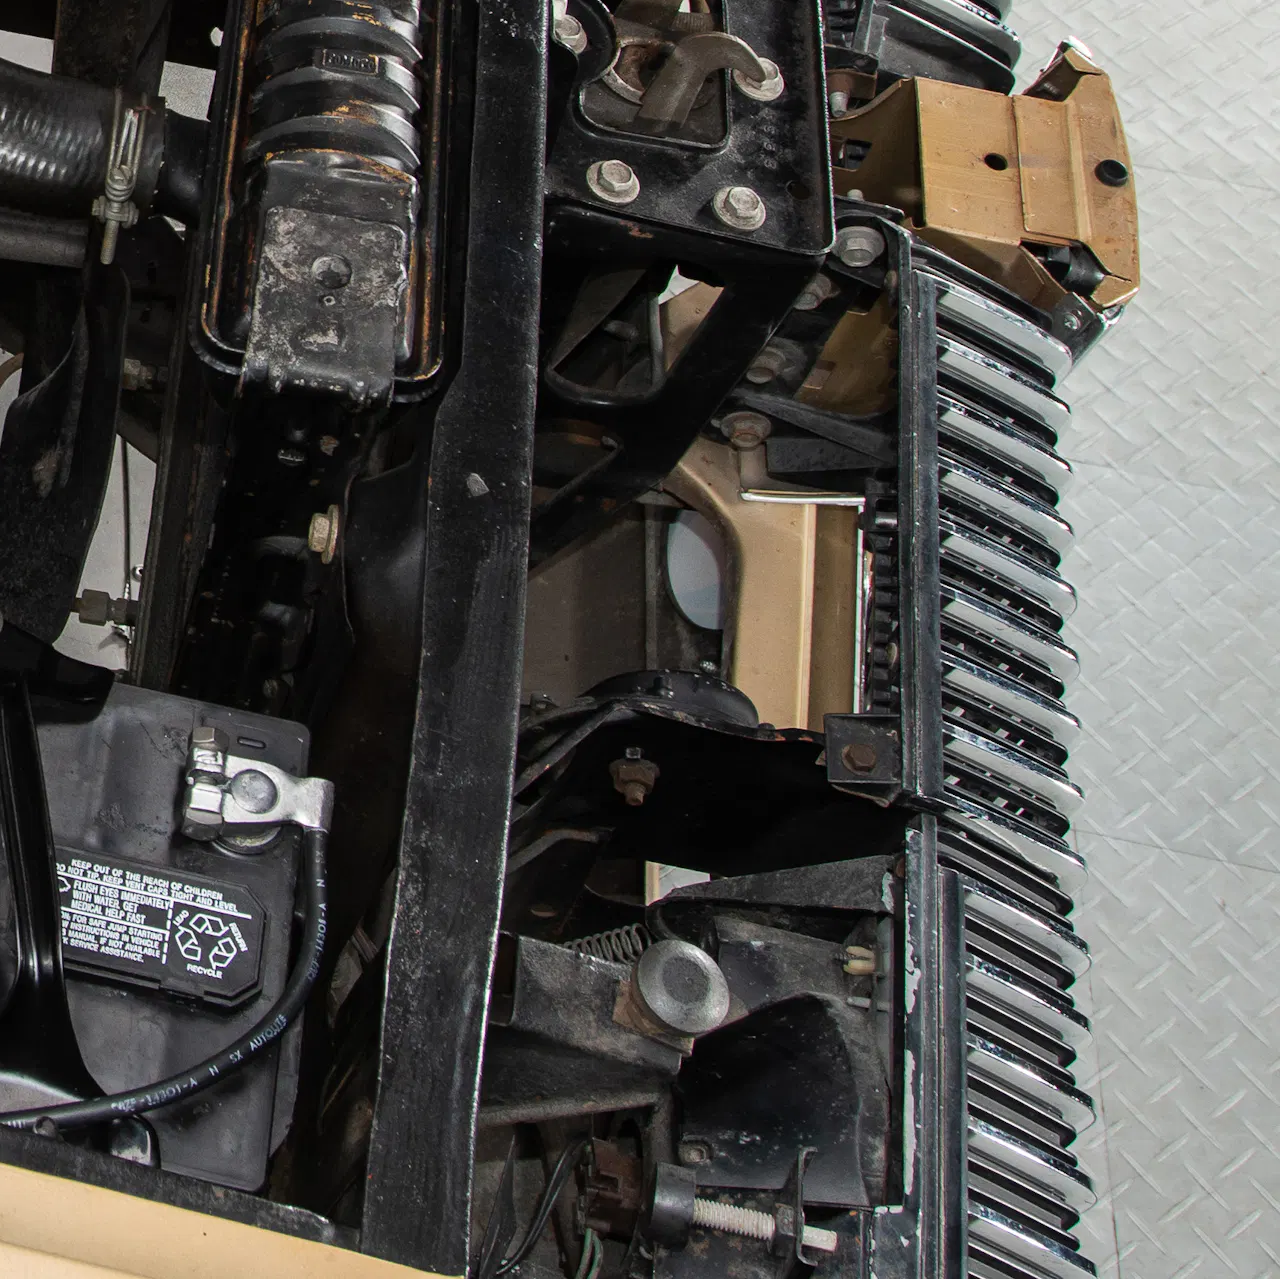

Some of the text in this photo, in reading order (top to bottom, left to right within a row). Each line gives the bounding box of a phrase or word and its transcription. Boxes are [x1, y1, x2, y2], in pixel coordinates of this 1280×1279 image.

[67, 866, 84, 876] NOT
[102, 874, 123, 885] KEEP
[125, 879, 146, 891] VENT
[147, 884, 168, 896] CAPS
[171, 890, 194, 902] TIGHT
[195, 896, 213, 906] AND
[71, 859, 223, 901] KEEP OUT OF THE REACH OF CHILDREN
[73, 880, 170, 910] FLUSH EYES IMMEDIATELY
[73, 889, 92, 902] WITH
[122, 901, 139, 913] GET
[71, 899, 103, 915] MEDICAL
[105, 907, 125, 919] HELP
[126, 912, 146, 924] FAST
[72, 914, 87, 924] FOR
[88, 918, 106, 929] SAFE
[172, 909, 189, 927] LEAD
[70, 938, 99, 952] SERVICE
[108, 939, 124, 949] NOT
[187, 963, 222, 979] RECYCLE
[208, 1064, 220, 1077] N
[248, 1014, 288, 1052] AUTOLITE
